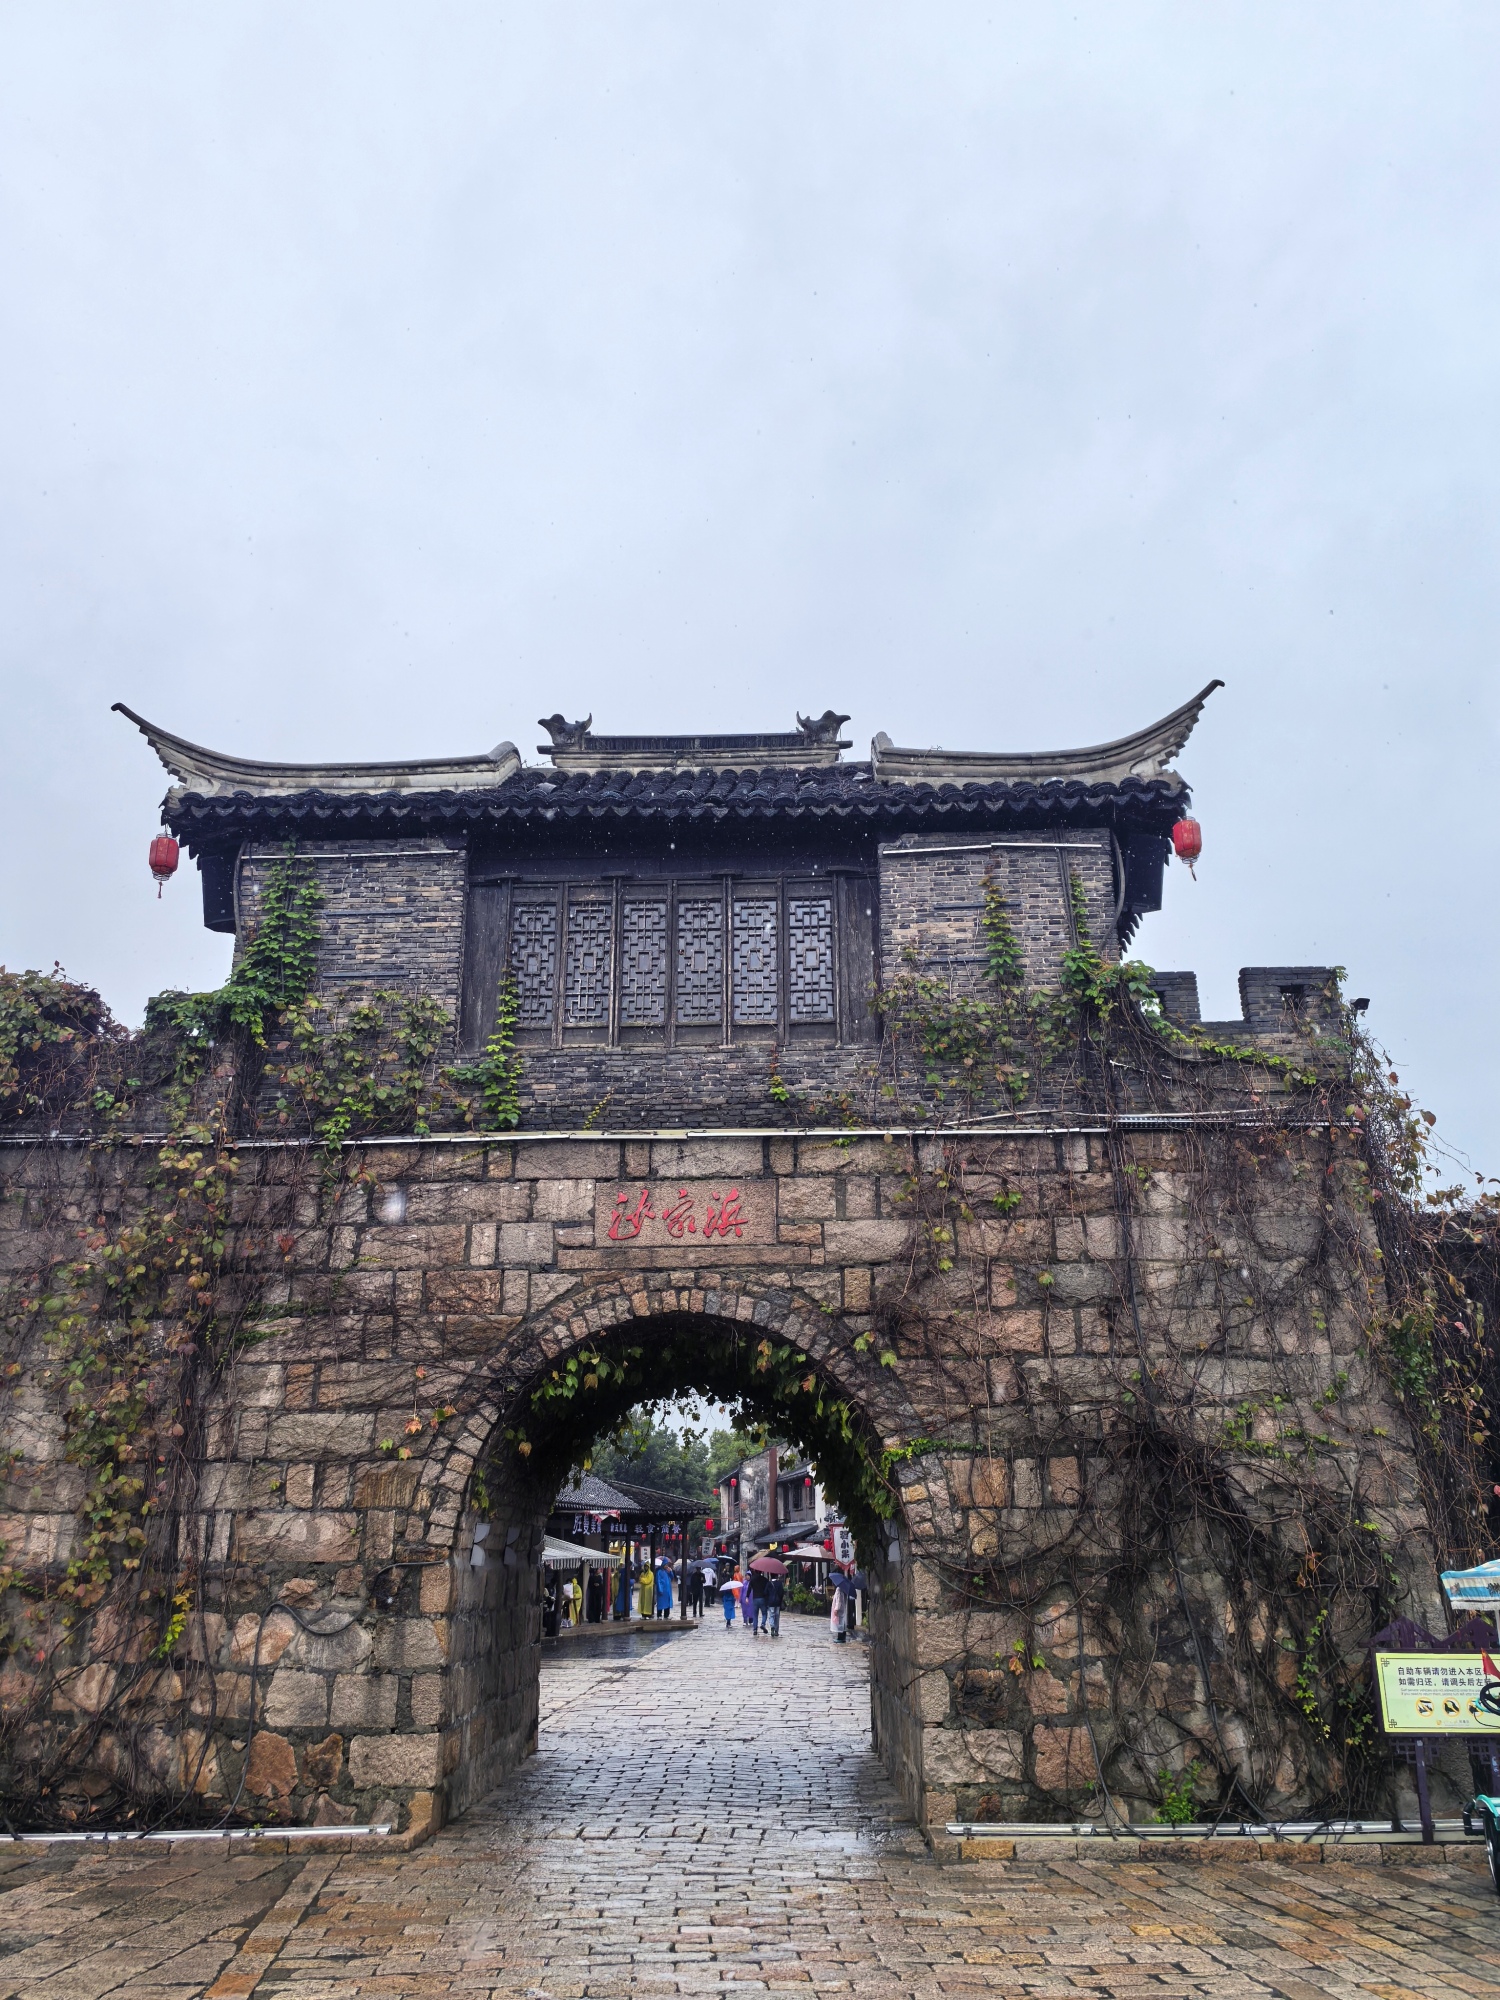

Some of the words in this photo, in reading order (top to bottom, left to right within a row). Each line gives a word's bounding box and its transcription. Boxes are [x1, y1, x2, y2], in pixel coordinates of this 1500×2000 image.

[608, 1187, 749, 1240] 沙家浜
[1398, 1667, 1490, 1676] 自助车辆请勿进入本区
